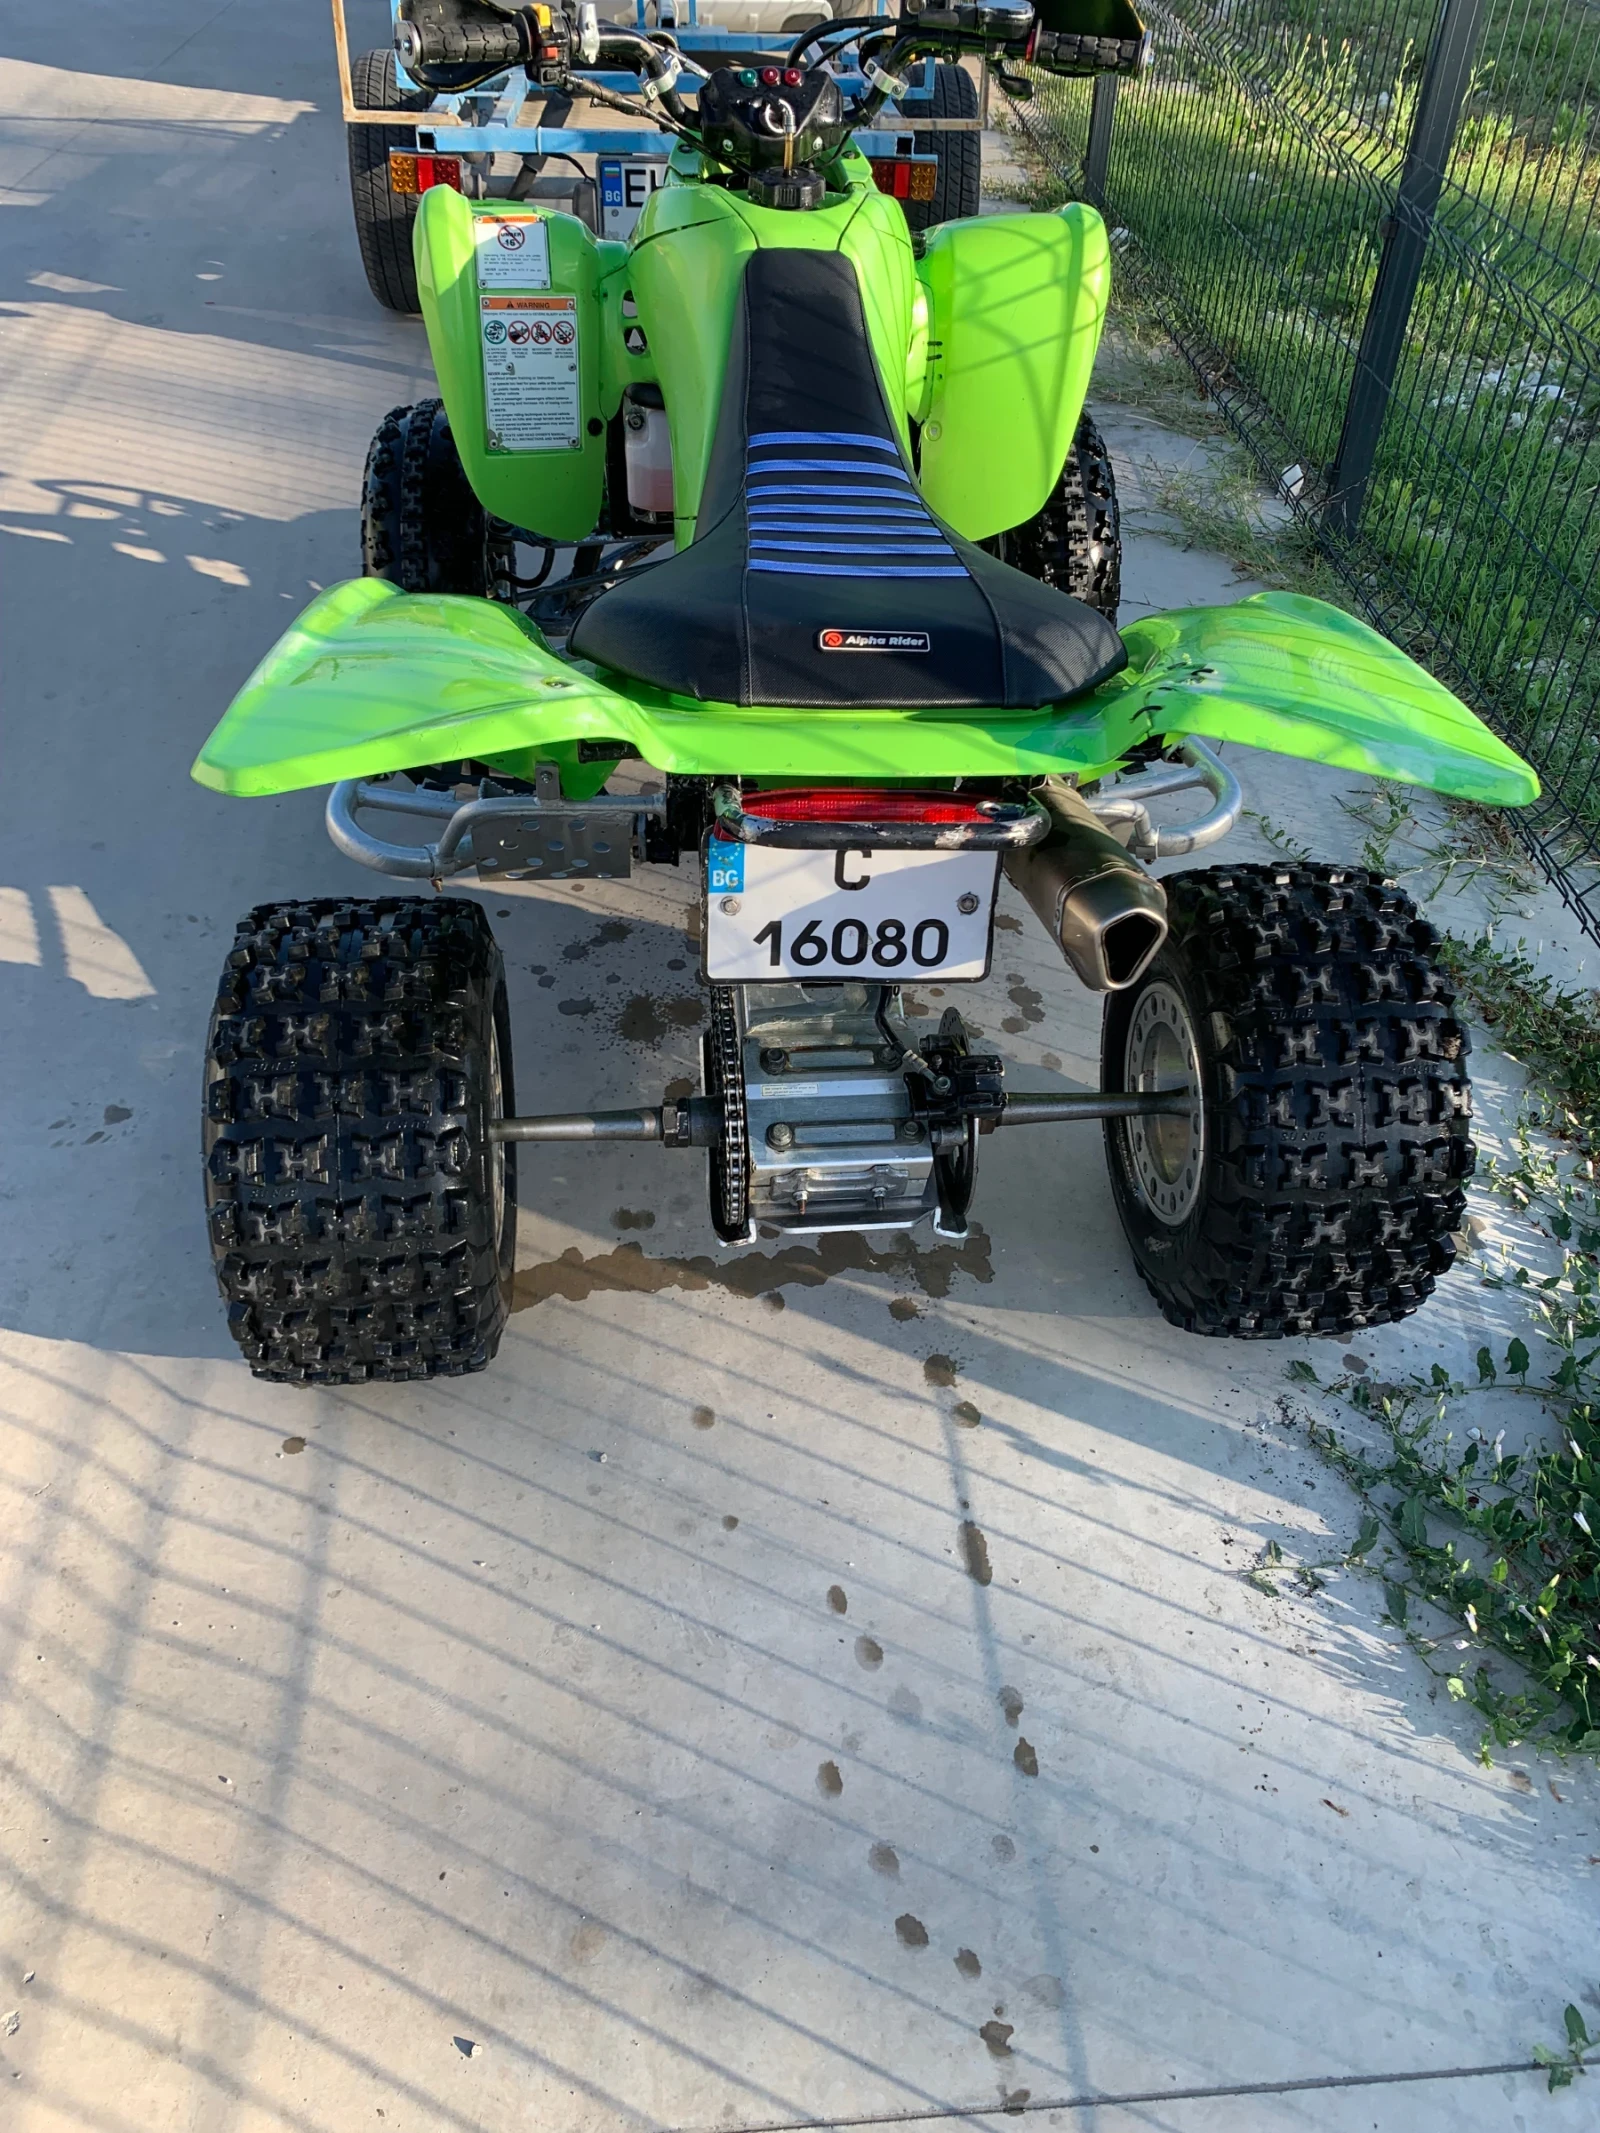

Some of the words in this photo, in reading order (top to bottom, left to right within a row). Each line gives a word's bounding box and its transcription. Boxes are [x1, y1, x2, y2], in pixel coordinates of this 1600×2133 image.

[605, 190, 621, 202] BG
[845, 636, 886, 646] Alpha
[889, 636, 924, 646] Rider
[712, 870, 738, 888] BG
[834, 849, 872, 891] C
[753, 918, 948, 967] 16080
